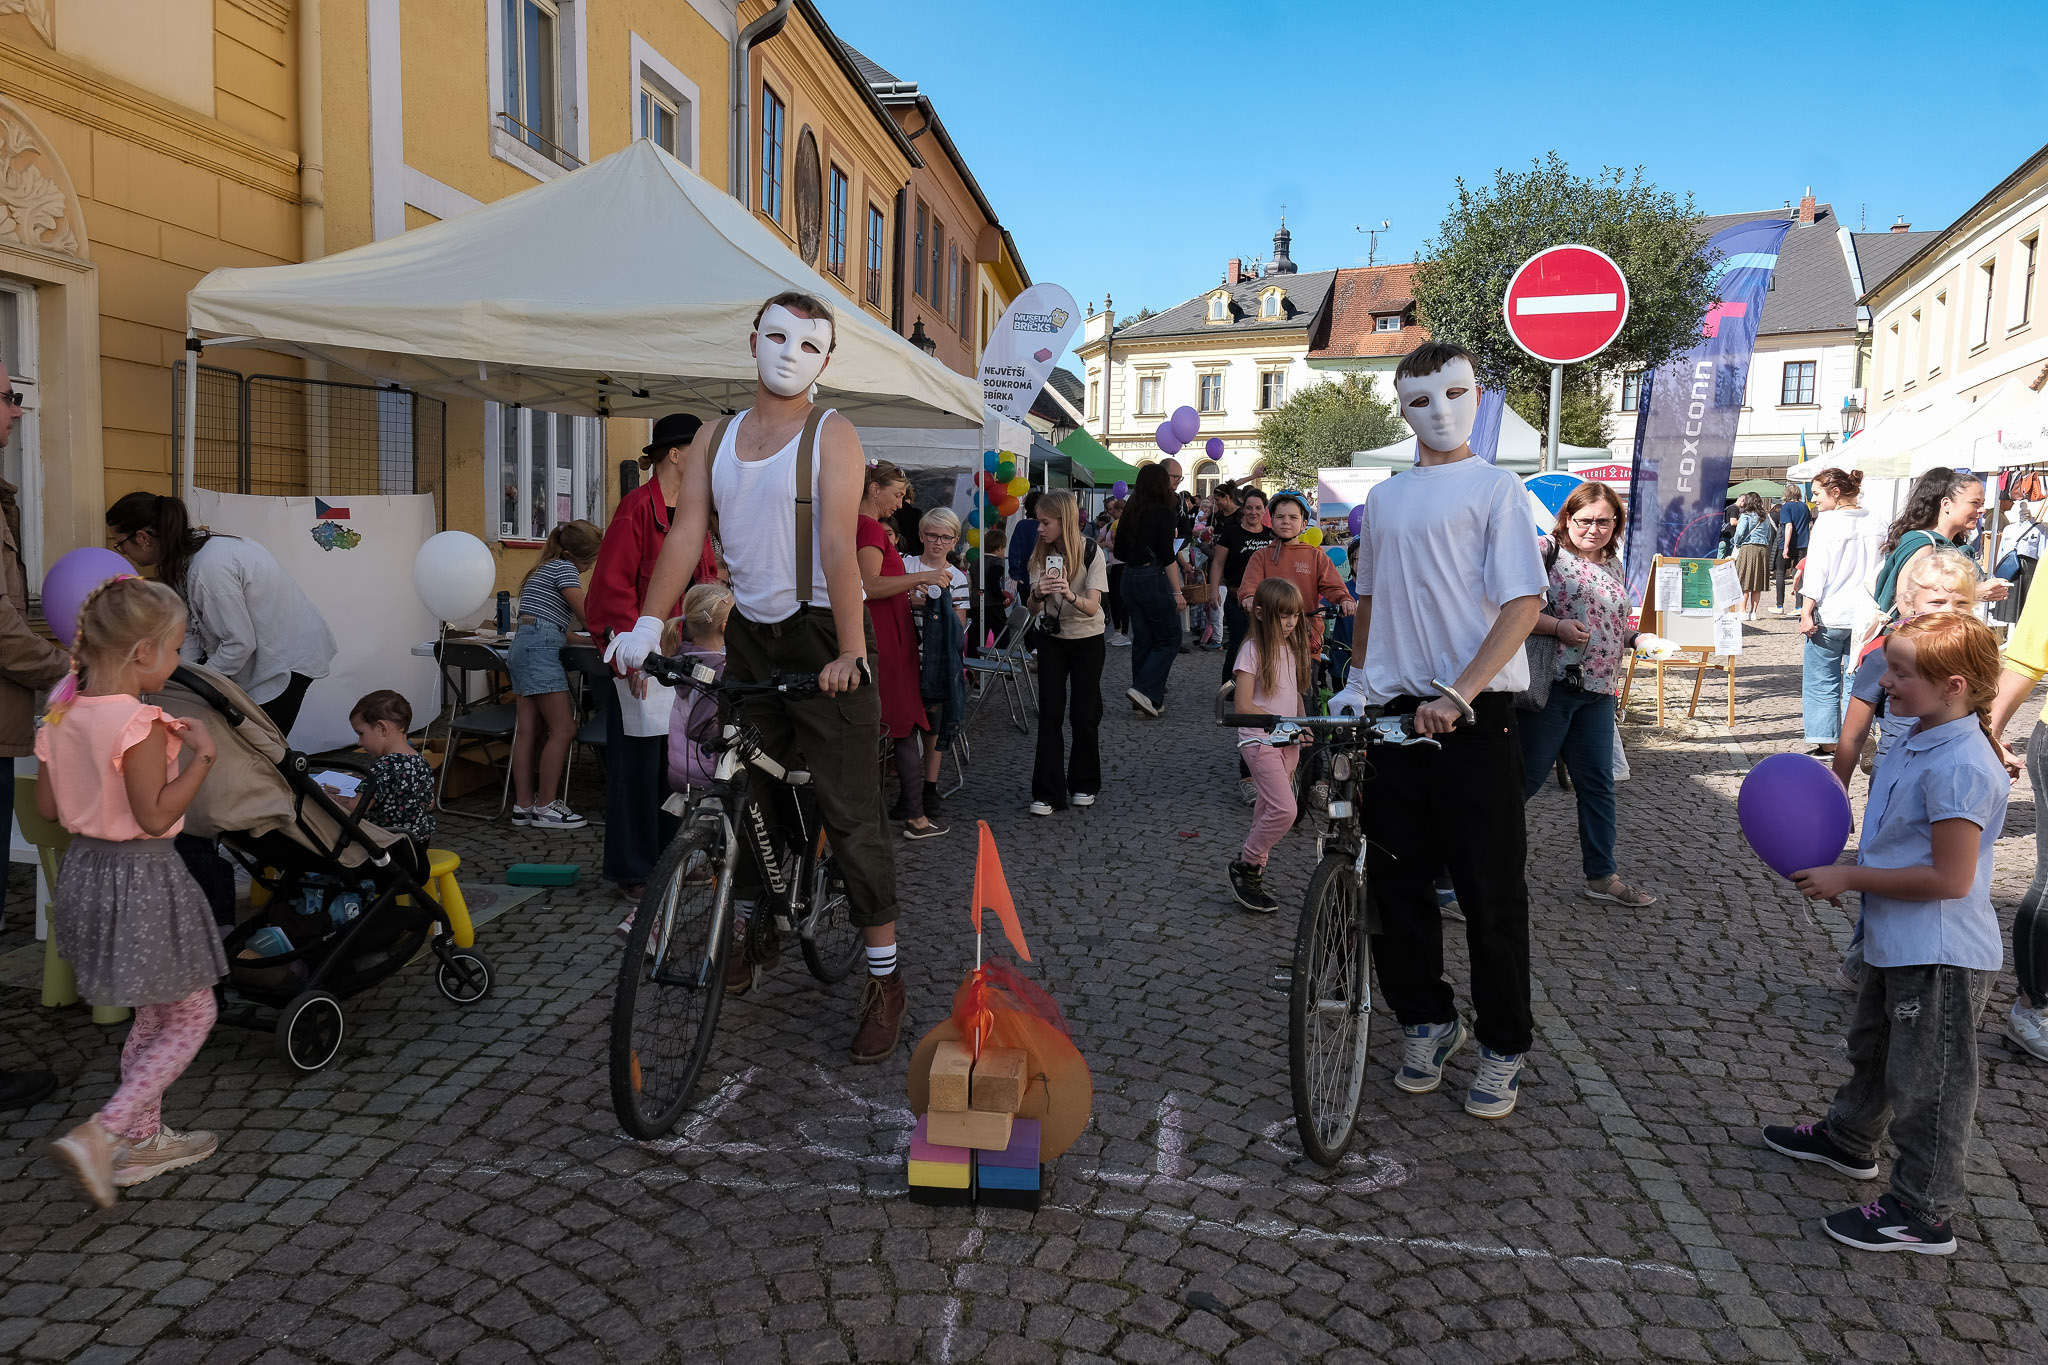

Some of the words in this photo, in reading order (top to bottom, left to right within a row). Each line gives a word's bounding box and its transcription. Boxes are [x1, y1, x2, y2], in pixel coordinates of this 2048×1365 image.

[1014, 313, 1052, 323] MUSEUM
[1013, 321, 1051, 332] BRICKS
[984, 365, 1026, 377] NEJVĚTŠÍ
[983, 379, 1032, 390] SOUKROMÁ
[983, 390, 1014, 401] SBÍRKA
[1676, 360, 1713, 493] FOXCONN
[1118, 441, 1159, 449] PENSIO
[748, 802, 787, 894] SPECIALIZED
